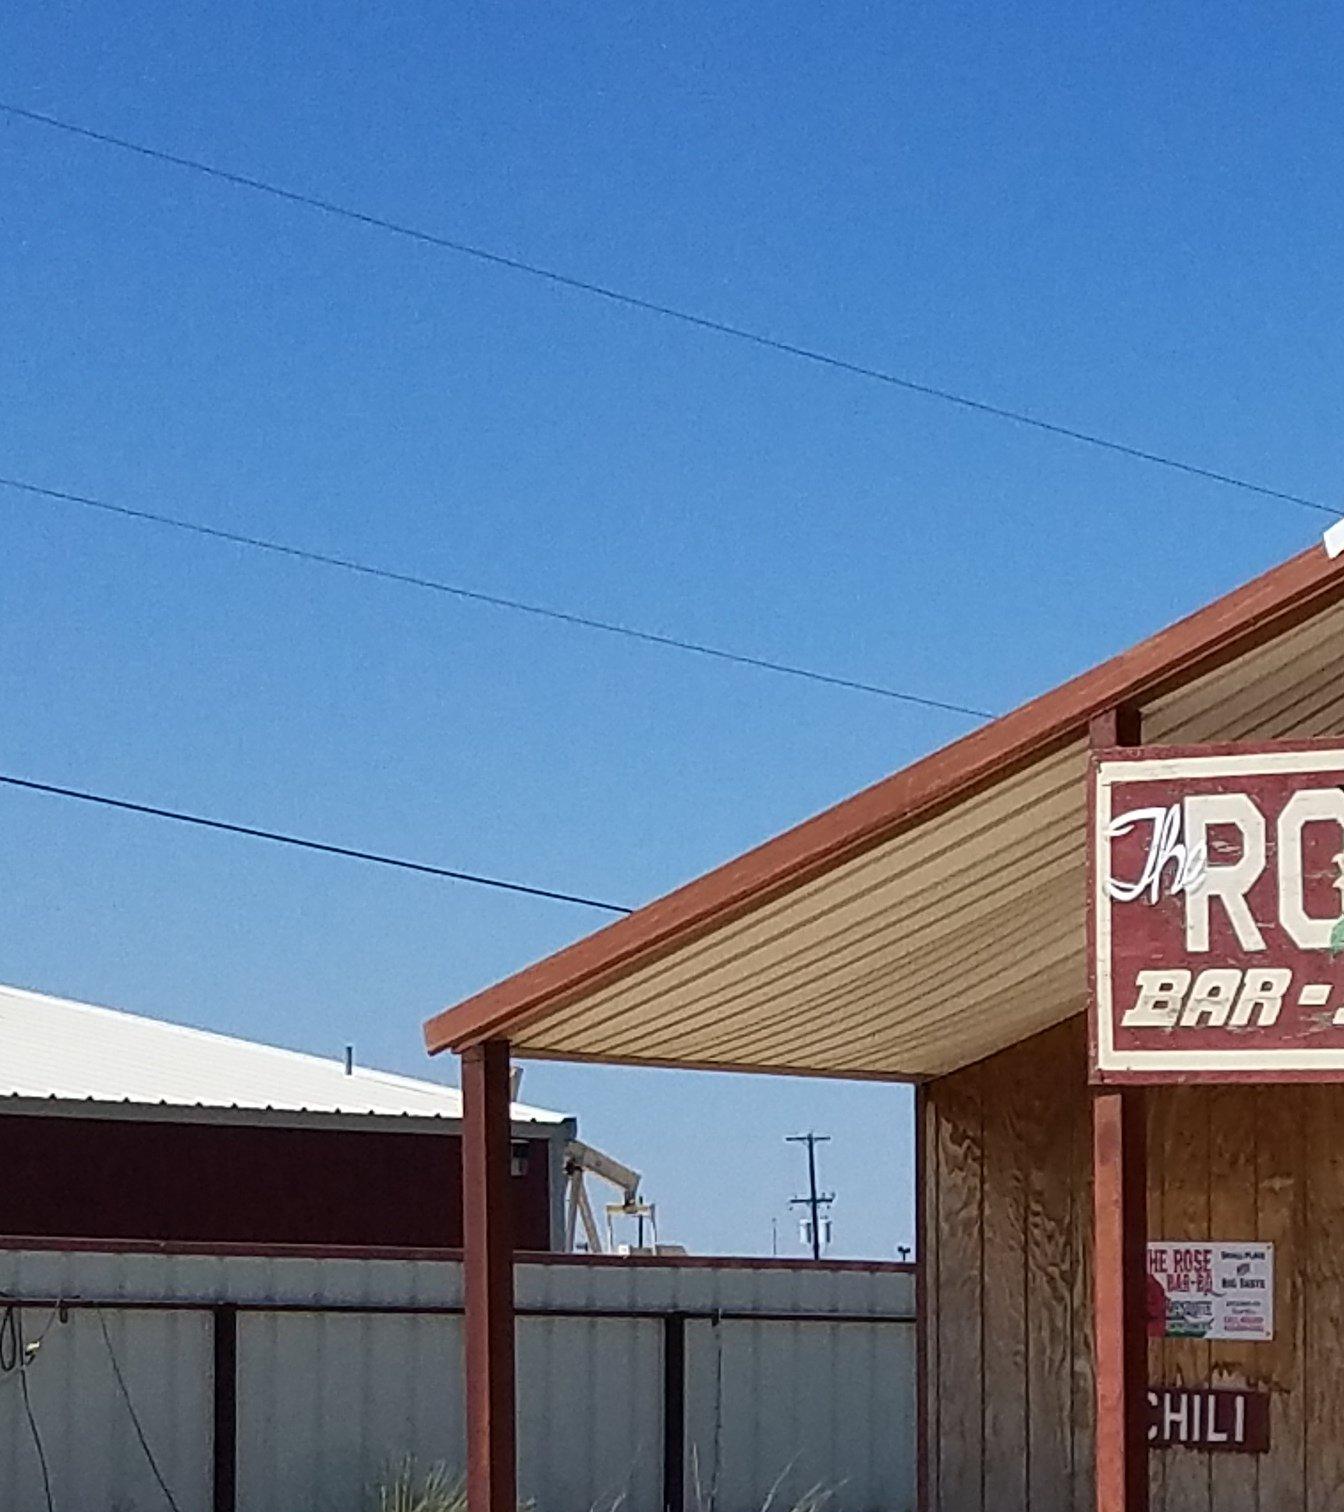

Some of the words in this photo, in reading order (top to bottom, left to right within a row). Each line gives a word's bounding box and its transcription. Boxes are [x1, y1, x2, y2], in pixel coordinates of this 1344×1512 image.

[1104, 803, 1209, 904] The
[1147, 1249, 1167, 1273] HE
[1173, 1249, 1212, 1274] ROSE
